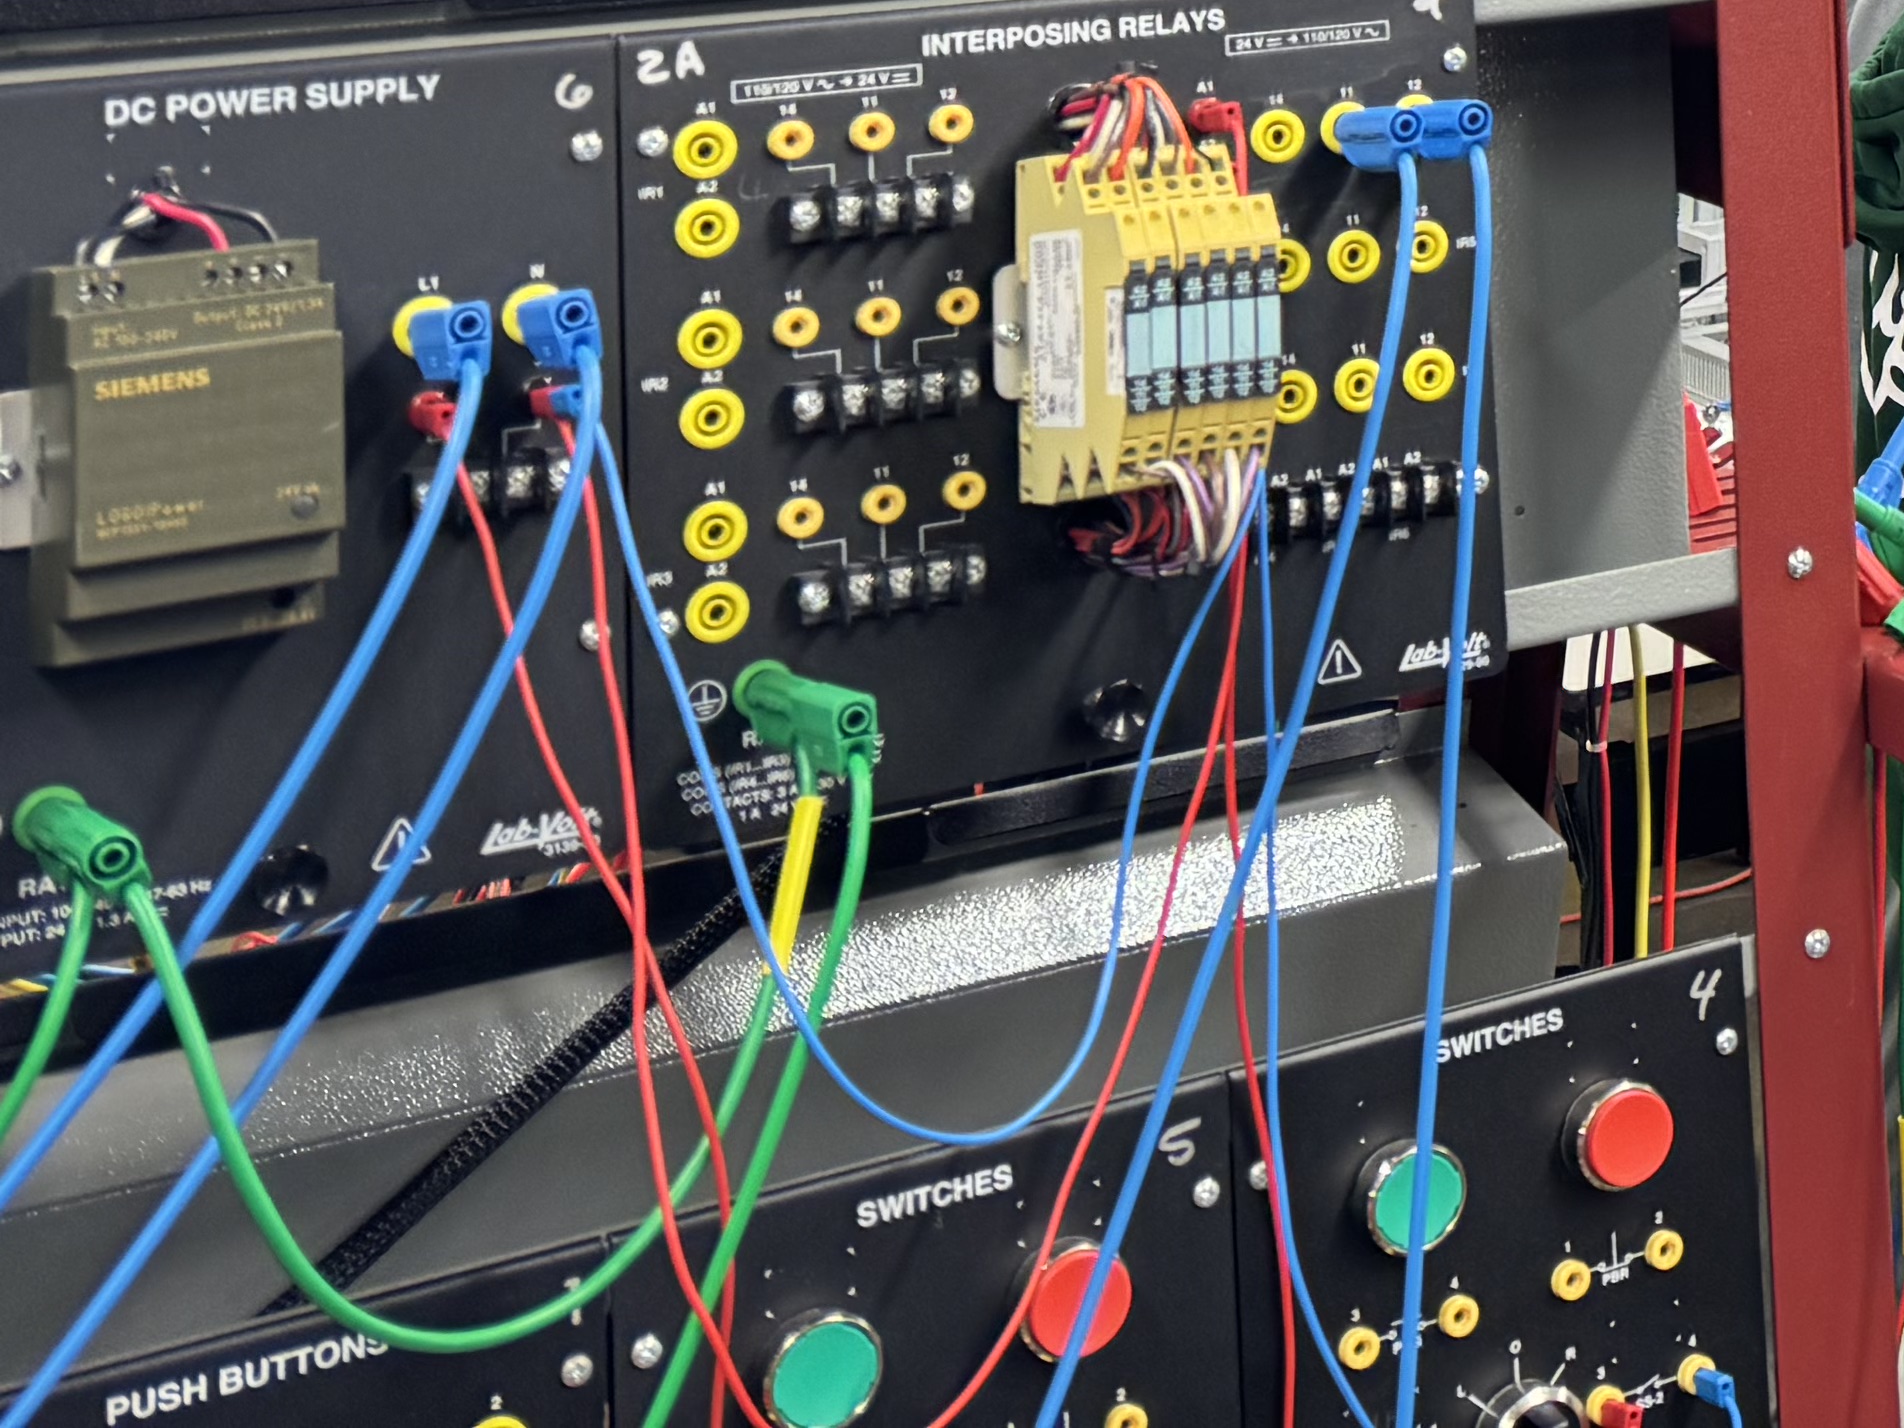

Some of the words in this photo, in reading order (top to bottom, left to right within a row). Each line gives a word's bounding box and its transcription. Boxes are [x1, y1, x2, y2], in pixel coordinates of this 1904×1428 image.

[922, 18, 1112, 57] INTERPOSING
[1118, 8, 1226, 38] RELAYS
[637, 40, 705, 84] 2A
[105, 96, 156, 127] DC
[166, 85, 297, 123] POWER
[306, 74, 441, 110] SUPPLY
[95, 367, 212, 401] SIEMENS
[1690, 969, 1722, 1021] 4
[1436, 1008, 1564, 1063] SWITCHES
[857, 1164, 1013, 1228] SWITCHES
[106, 1374, 208, 1426] PUSH
